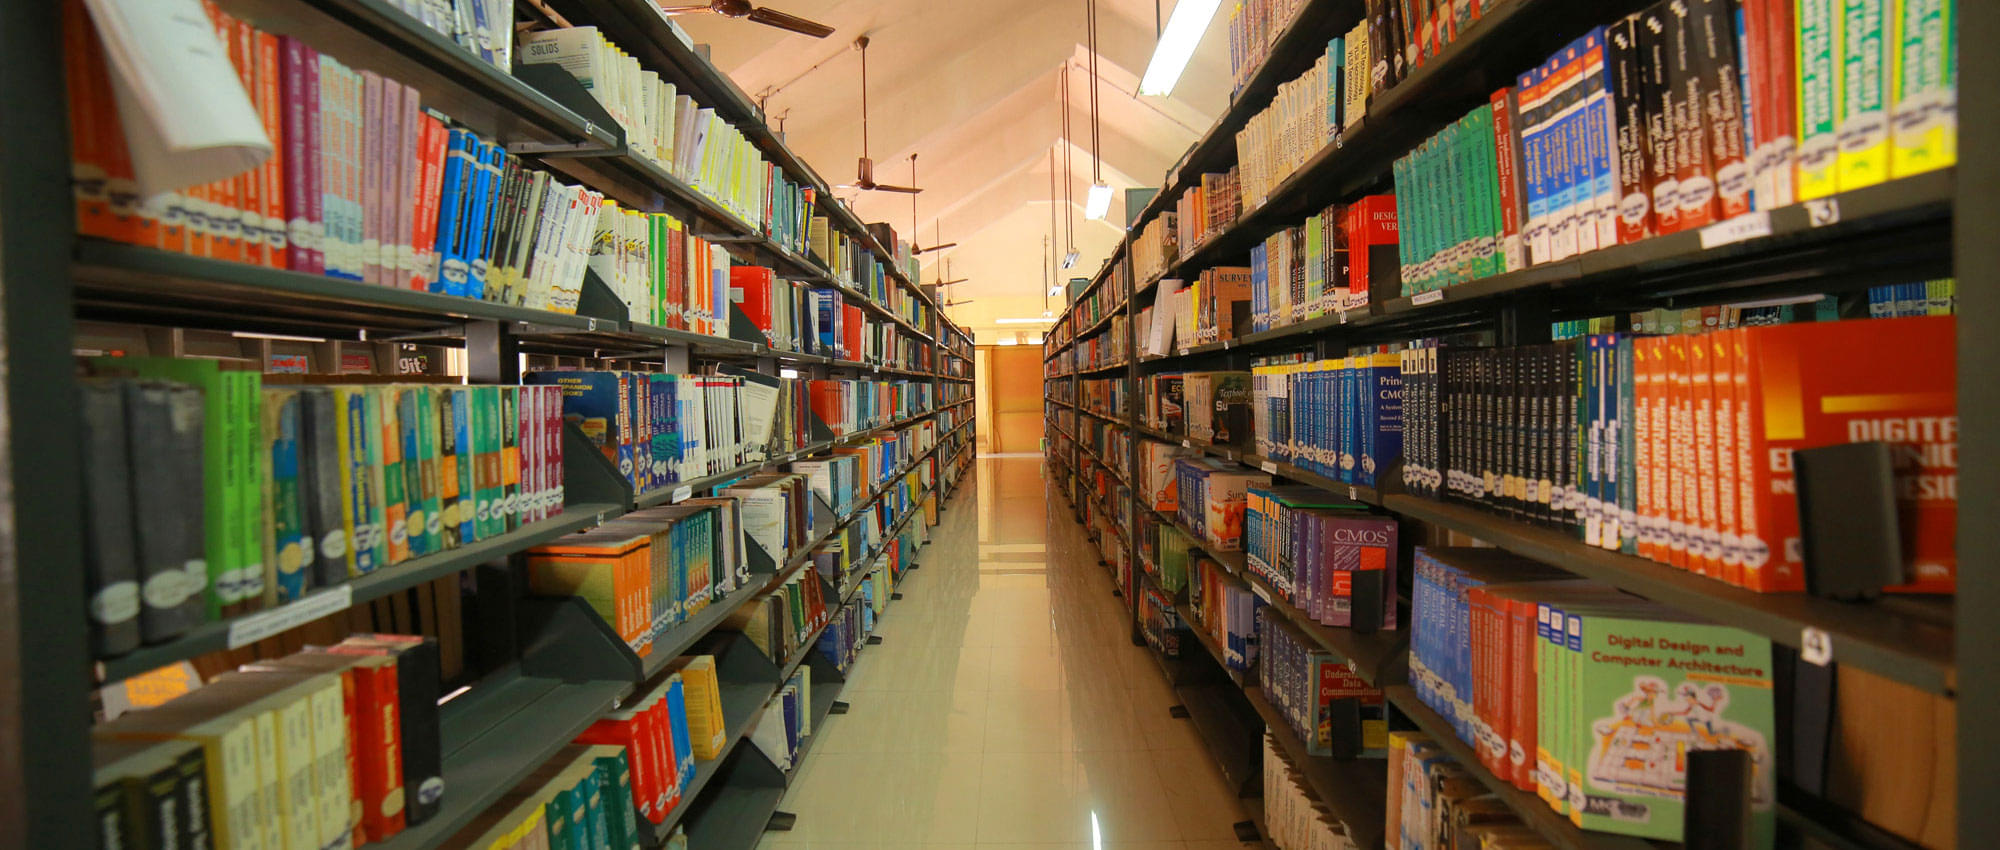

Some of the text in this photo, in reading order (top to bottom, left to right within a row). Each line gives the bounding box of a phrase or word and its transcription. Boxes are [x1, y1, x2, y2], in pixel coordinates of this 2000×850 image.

[531, 43, 559, 56] SOLIDS
[1334, 528, 1388, 544] CMOS
[1607, 634, 1745, 657] Digital Design and
[1592, 651, 1764, 678] Computer Architecture
[1343, 679, 1362, 688] Data
[1321, 687, 1381, 697] Communications
